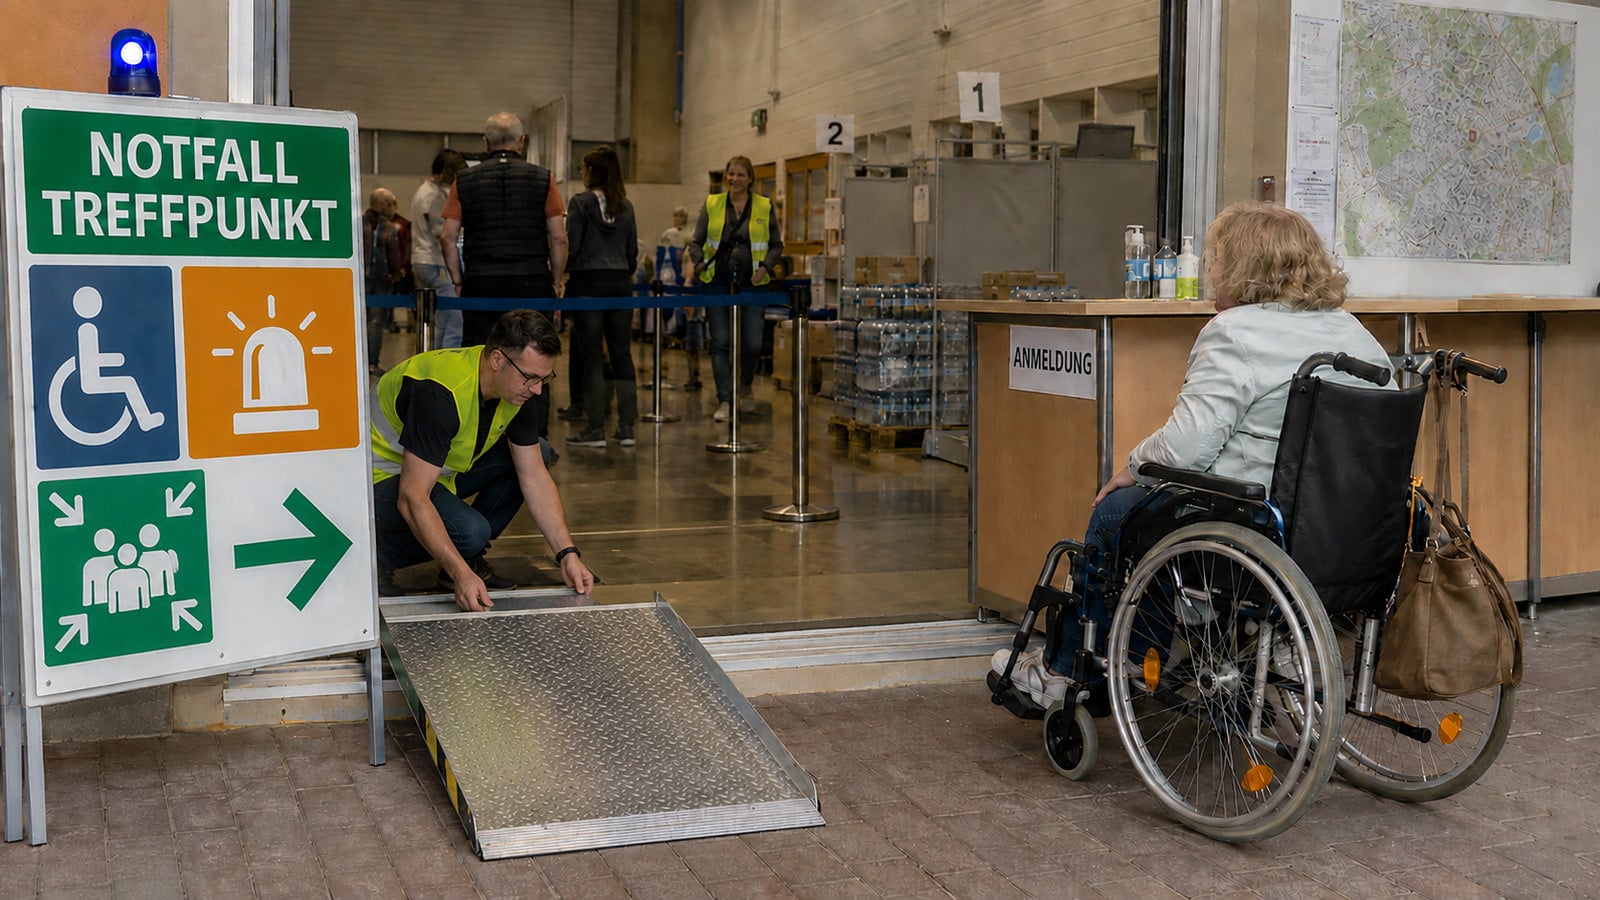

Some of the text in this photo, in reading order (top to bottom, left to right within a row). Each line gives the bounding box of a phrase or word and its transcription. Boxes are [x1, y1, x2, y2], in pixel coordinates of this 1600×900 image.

[972, 82, 985, 113] 1
[827, 121, 844, 146] 2
[90, 131, 299, 184] NOTFALL
[41, 190, 338, 241] TREFFPUNKT
[1013, 346, 1092, 376] ANMELDUNG
